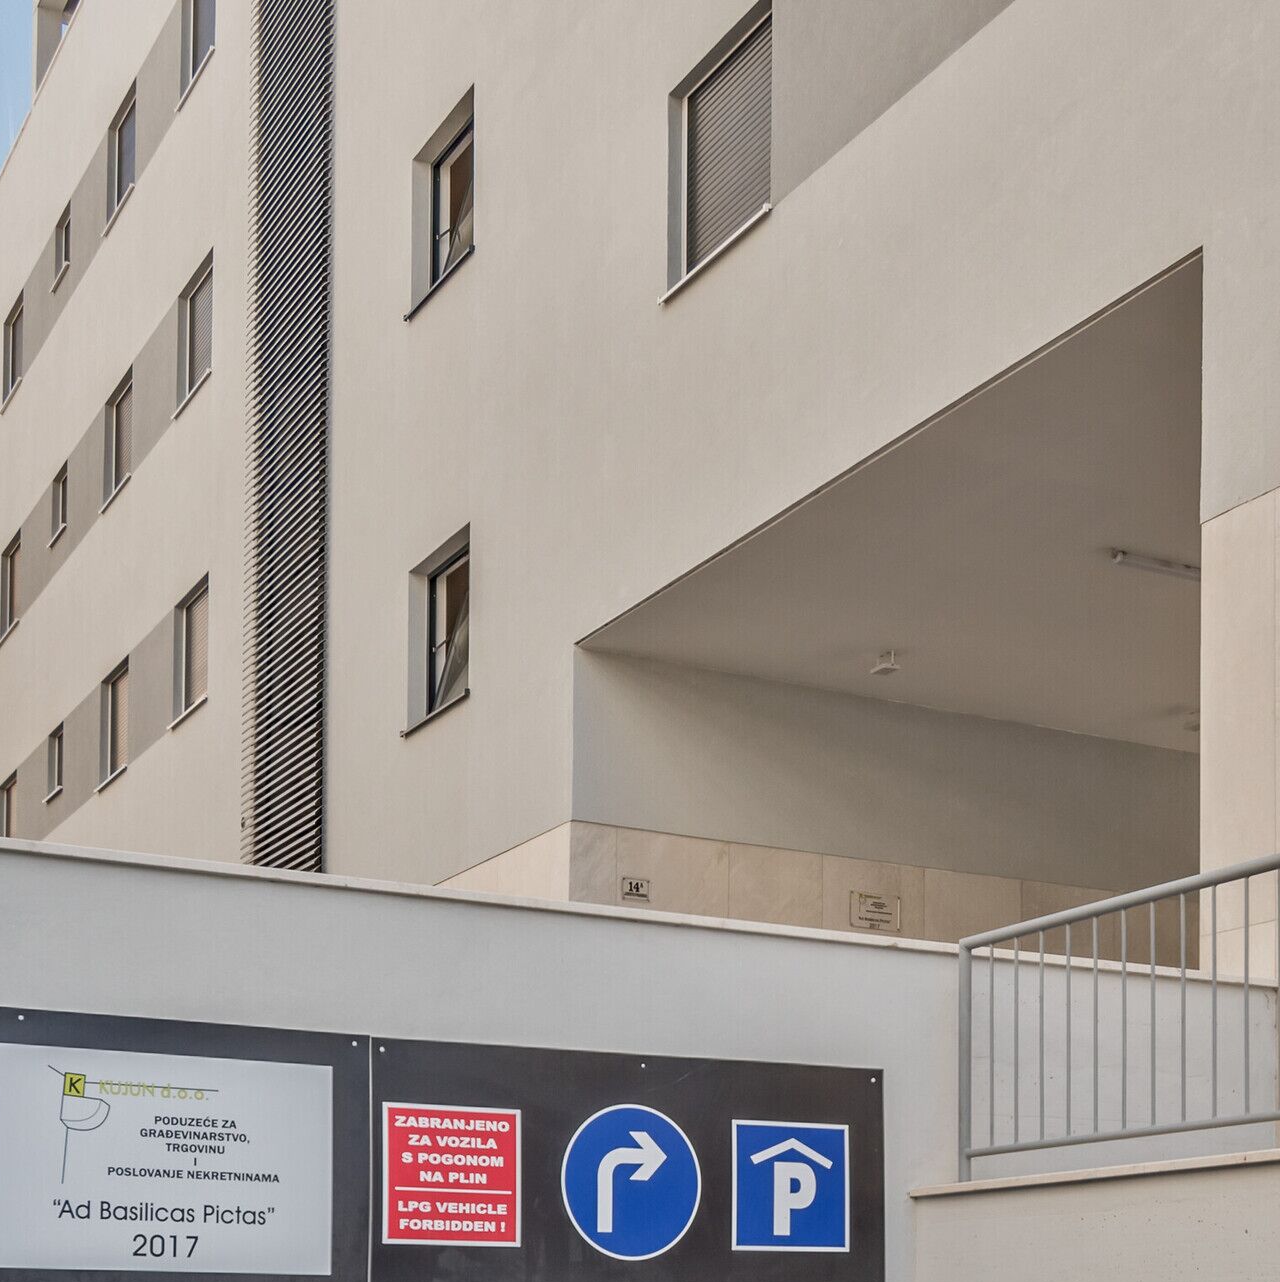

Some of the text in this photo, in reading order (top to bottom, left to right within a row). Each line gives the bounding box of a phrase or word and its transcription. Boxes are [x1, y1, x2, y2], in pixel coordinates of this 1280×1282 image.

[69, 1077, 81, 1094] K
[98, 1079, 209, 1101] KUJUN d.o.o.
[154, 1113, 237, 1129] PODUZEĆE ZA
[394, 1115, 510, 1133] ZABRANJENO
[140, 1128, 250, 1144] GRAĐEVINARSTVO,
[408, 1134, 497, 1149] ZA VOZILA
[165, 1143, 225, 1154] TRGOVINU
[401, 1152, 504, 1167] S POGONOM
[107, 1166, 280, 1183] POSLOVANJE NEKRETNINAMA
[419, 1170, 487, 1184] NA PLIN
[773, 1160, 817, 1236] P
[99, 1200, 195, 1223] Basilicas
[397, 1200, 508, 1215] LPG VEHICLE
[399, 1218, 496, 1232] FORBIDDEN
[132, 1233, 199, 1258] 2017
